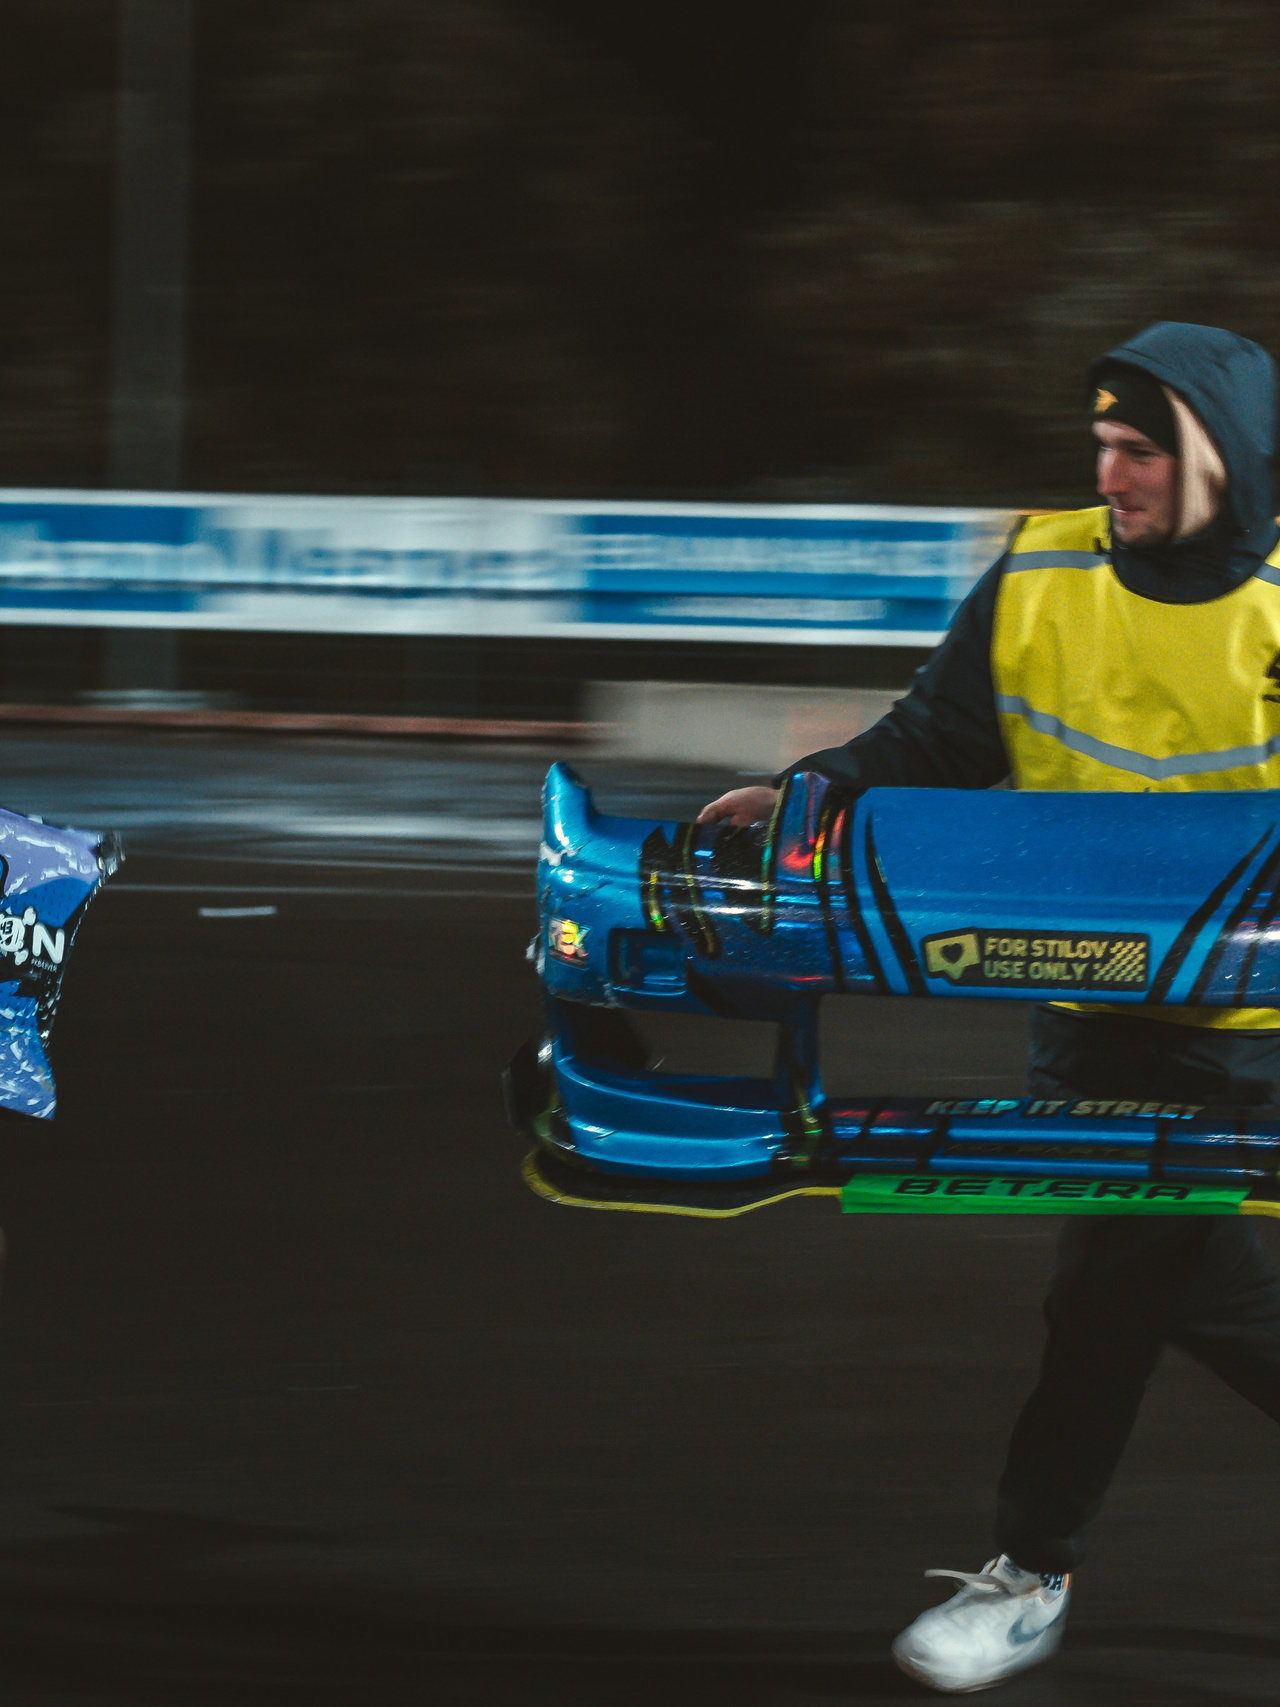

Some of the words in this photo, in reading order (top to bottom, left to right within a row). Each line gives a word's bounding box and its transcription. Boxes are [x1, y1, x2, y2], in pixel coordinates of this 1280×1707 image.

[983, 937, 1029, 957] FOR
[1031, 938, 1110, 960] STILOV
[982, 960, 1027, 979] USE
[1028, 961, 1090, 981] ONLY
[924, 1099, 1020, 1116] KEEP
[1027, 1100, 1068, 1116] IT
[1070, 1101, 1206, 1120] STREET
[893, 1178, 1192, 1200] BETERA
